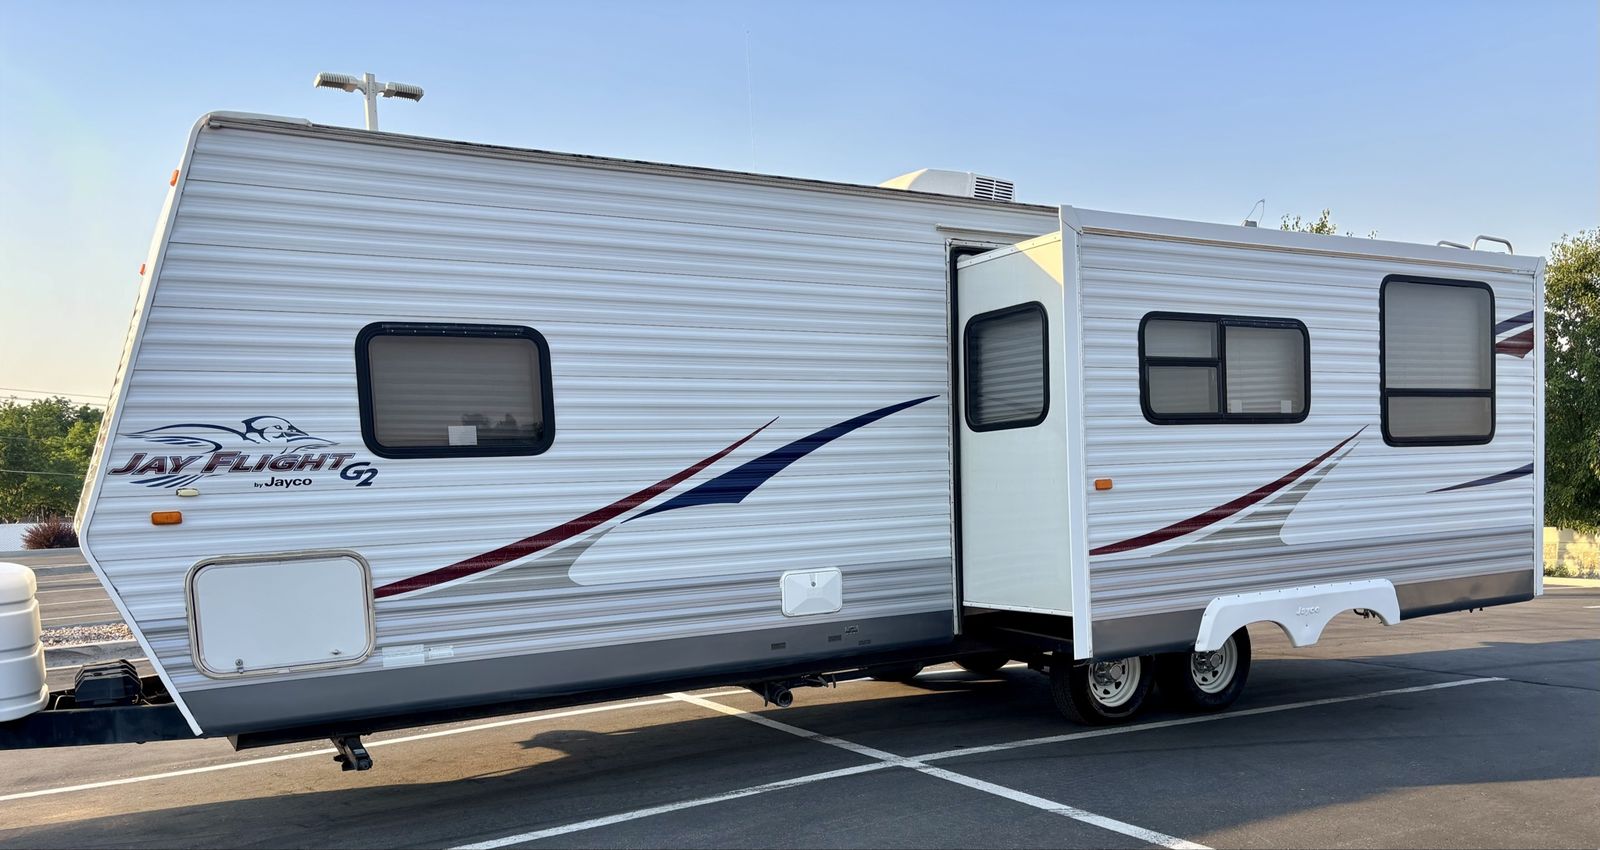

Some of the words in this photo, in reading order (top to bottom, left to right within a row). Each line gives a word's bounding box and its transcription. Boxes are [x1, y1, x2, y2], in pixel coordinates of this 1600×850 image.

[108, 453, 203, 475] JAY
[200, 451, 356, 473] FLIGHT
[339, 462, 378, 487] G2
[264, 476, 312, 488] Jayco
[1296, 606, 1320, 616] Jayco
